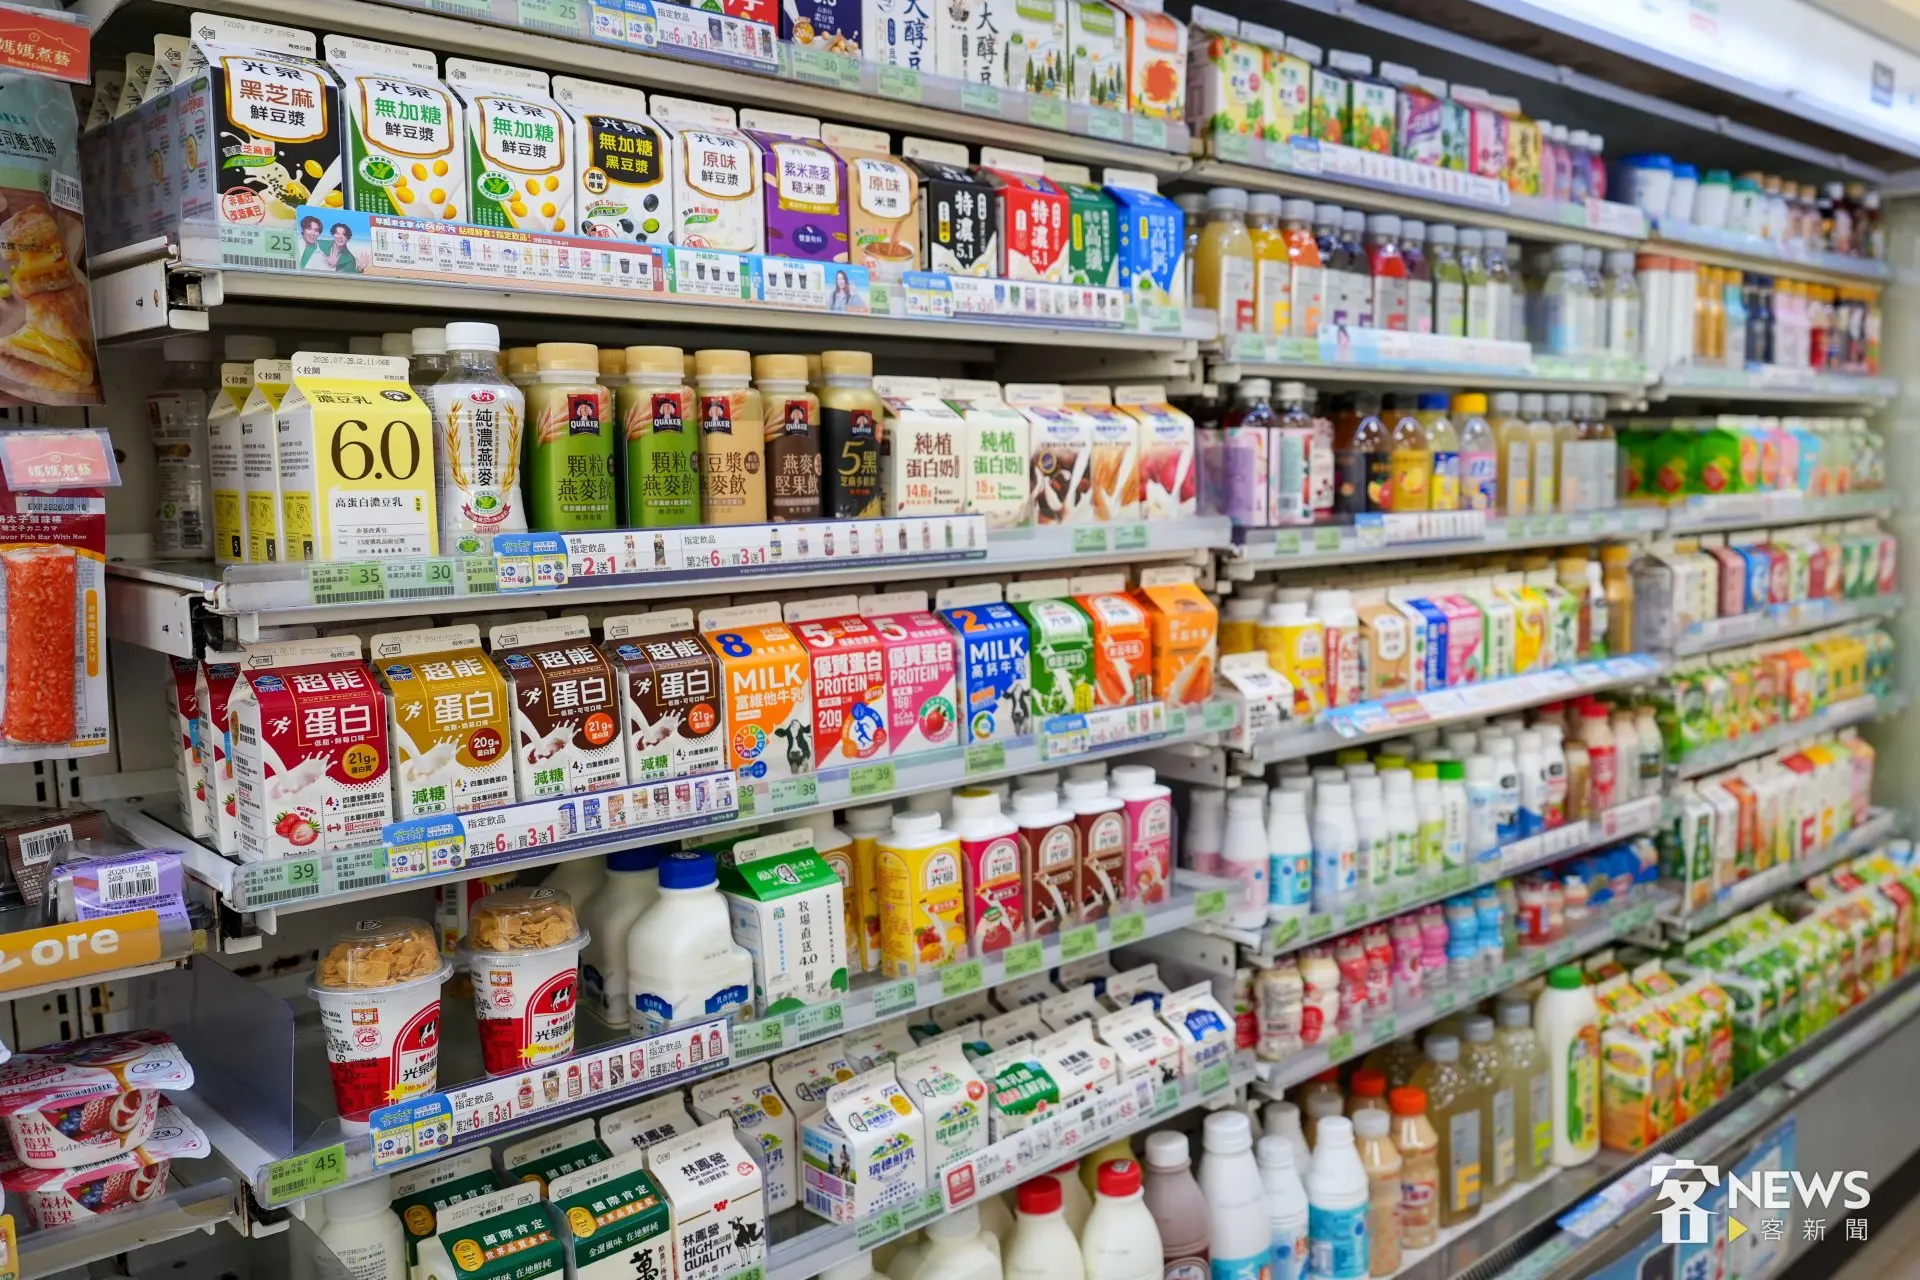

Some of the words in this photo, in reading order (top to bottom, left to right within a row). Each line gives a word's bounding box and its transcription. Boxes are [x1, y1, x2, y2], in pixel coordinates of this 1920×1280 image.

[559, 5, 577, 20] 25
[657, 8, 690, 22] 指定飲品
[242, 60, 304, 81] 光泉
[240, 80, 315, 109] 黑芝麻
[376, 80, 432, 100] 光泉
[250, 104, 306, 126] 鮮豆漿
[374, 97, 442, 126] 無加糖
[496, 100, 546, 118] 光泉
[384, 122, 434, 143] 鮮豆漿
[492, 116, 554, 143] 無加糖
[598, 118, 646, 136] 光泉
[502, 140, 547, 159] 鮮豆漿
[598, 132, 653, 158] 無加糖
[694, 132, 737, 148] 光泉
[606, 154, 649, 174] 黑豆漿
[702, 150, 737, 170] 原味
[701, 171, 740, 188] 鮮豆漿
[784, 160, 832, 182] 紫米燕麥
[791, 180, 827, 197] 糙米漿
[868, 176, 900, 194] 原味
[874, 196, 898, 210] 米漿
[954, 190, 974, 242] 特濃
[1031, 198, 1050, 248] 特濃
[270, 236, 292, 252] 25
[956, 244, 974, 259] 5.1
[1032, 249, 1048, 266] 5.1
[875, 290, 888, 300] 25
[304, 366, 320, 374] 拉開
[316, 394, 373, 405] 濃豆乳
[570, 418, 600, 430] QUAKER
[653, 417, 682, 428] QUAKER
[703, 420, 731, 430] QUAKER
[786, 423, 808, 432] QUAKER
[330, 419, 421, 481] 6.0
[476, 408, 493, 487] 純濃燕麥
[914, 432, 952, 456] 純植
[980, 430, 1016, 454] 純植
[567, 454, 603, 478] 顆粒
[651, 450, 687, 475] 顆粒
[708, 450, 744, 474] 豆漿
[782, 454, 813, 476] 燕麥
[838, 440, 877, 476] 5黑
[906, 456, 955, 478] 蛋白奶
[974, 456, 1020, 476] 蛋白奶
[558, 477, 612, 502] 燕麥飲
[643, 474, 696, 497] 燕麥飲
[774, 474, 818, 496] 堅果飲
[335, 496, 403, 508] 高蛋白濃豆乳
[570, 543, 606, 554] 指定飲品
[684, 535, 716, 546] 指定飲品
[571, 556, 617, 577] 買2送1
[686, 549, 728, 568] 第2件6折
[731, 547, 766, 566] 買3送1
[360, 568, 380, 584] 35
[431, 565, 452, 580] 30
[872, 617, 908, 642] 5
[952, 610, 987, 634] 2
[716, 632, 753, 658] 8
[800, 623, 836, 648] 5
[538, 646, 598, 670] 超能
[646, 639, 702, 661] 超能
[888, 641, 952, 669] 優質蛋白
[970, 636, 1025, 664] MILK
[420, 658, 486, 682] 超能
[813, 650, 883, 678] 優質蛋白
[292, 670, 364, 694] 超能
[660, 669, 710, 700] 蛋白
[733, 662, 804, 694] MILK
[816, 674, 868, 697] PROTEIN
[890, 664, 939, 686] PROTEIN
[552, 676, 607, 710] 蛋白
[434, 690, 494, 724] 蛋白
[692, 712, 710, 722] 21g
[304, 704, 371, 738] 蛋白
[588, 721, 608, 732] 21g
[818, 710, 842, 728] 20g
[474, 737, 495, 749] 20g
[348, 752, 371, 766] 21g
[572, 760, 579, 770] 4
[640, 754, 668, 771] 減糖
[454, 778, 462, 789] 4
[534, 768, 564, 786] 減糖
[875, 766, 890, 780] 39
[412, 784, 446, 806] 減糖
[740, 785, 754, 798] 39
[800, 783, 816, 795] 39
[325, 796, 334, 806] 4
[467, 814, 506, 830] 指定飲品
[470, 833, 514, 857] 第2件6折
[518, 824, 555, 848] 買3送1
[107, 866, 151, 876] 2026.07.24
[294, 862, 314, 880] 39
[798, 900, 812, 953] 牧場直送
[800, 953, 818, 966] 4.0
[805, 970, 816, 993] 鮮乳
[900, 984, 915, 998] 39
[828, 1005, 842, 1019] 39
[766, 1024, 781, 1036] 52
[650, 1040, 682, 1056] 指定飲品
[454, 1092, 494, 1111] 指定飲品
[20, 1120, 50, 1135] 森林
[456, 1110, 485, 1134] 第2件6折
[488, 1101, 512, 1124] 買3送1
[935, 1114, 980, 1140] 瑞穗鮮乳
[24, 1136, 53, 1150] 莓果
[631, 1123, 675, 1147] 林鳳營
[315, 1153, 336, 1171] 45
[546, 1153, 600, 1180] 國際肯定
[680, 1152, 726, 1177] 林鳳營
[700, 1167, 719, 1178] QUALITY
[868, 1147, 915, 1177] 瑞穗鮮乳
[698, 1170, 729, 1186] 高品質鮮乳
[40, 1196, 70, 1208] 森林
[592, 1184, 649, 1213] 國際肯定
[43, 1210, 72, 1224] 莓果
[596, 1196, 654, 1226] 世界品質金獎
[482, 1218, 546, 1246] 國際肯定
[588, 1236, 622, 1258] 金選風味
[626, 1221, 660, 1242] 在地鮮純
[682, 1222, 720, 1249] 林鳳營
[486, 1233, 549, 1260] 世界品質金獎
[684, 1240, 712, 1260] HIGH
[684, 1242, 732, 1272] QUALITY
[515, 1258, 552, 1279] 在地鮮純
